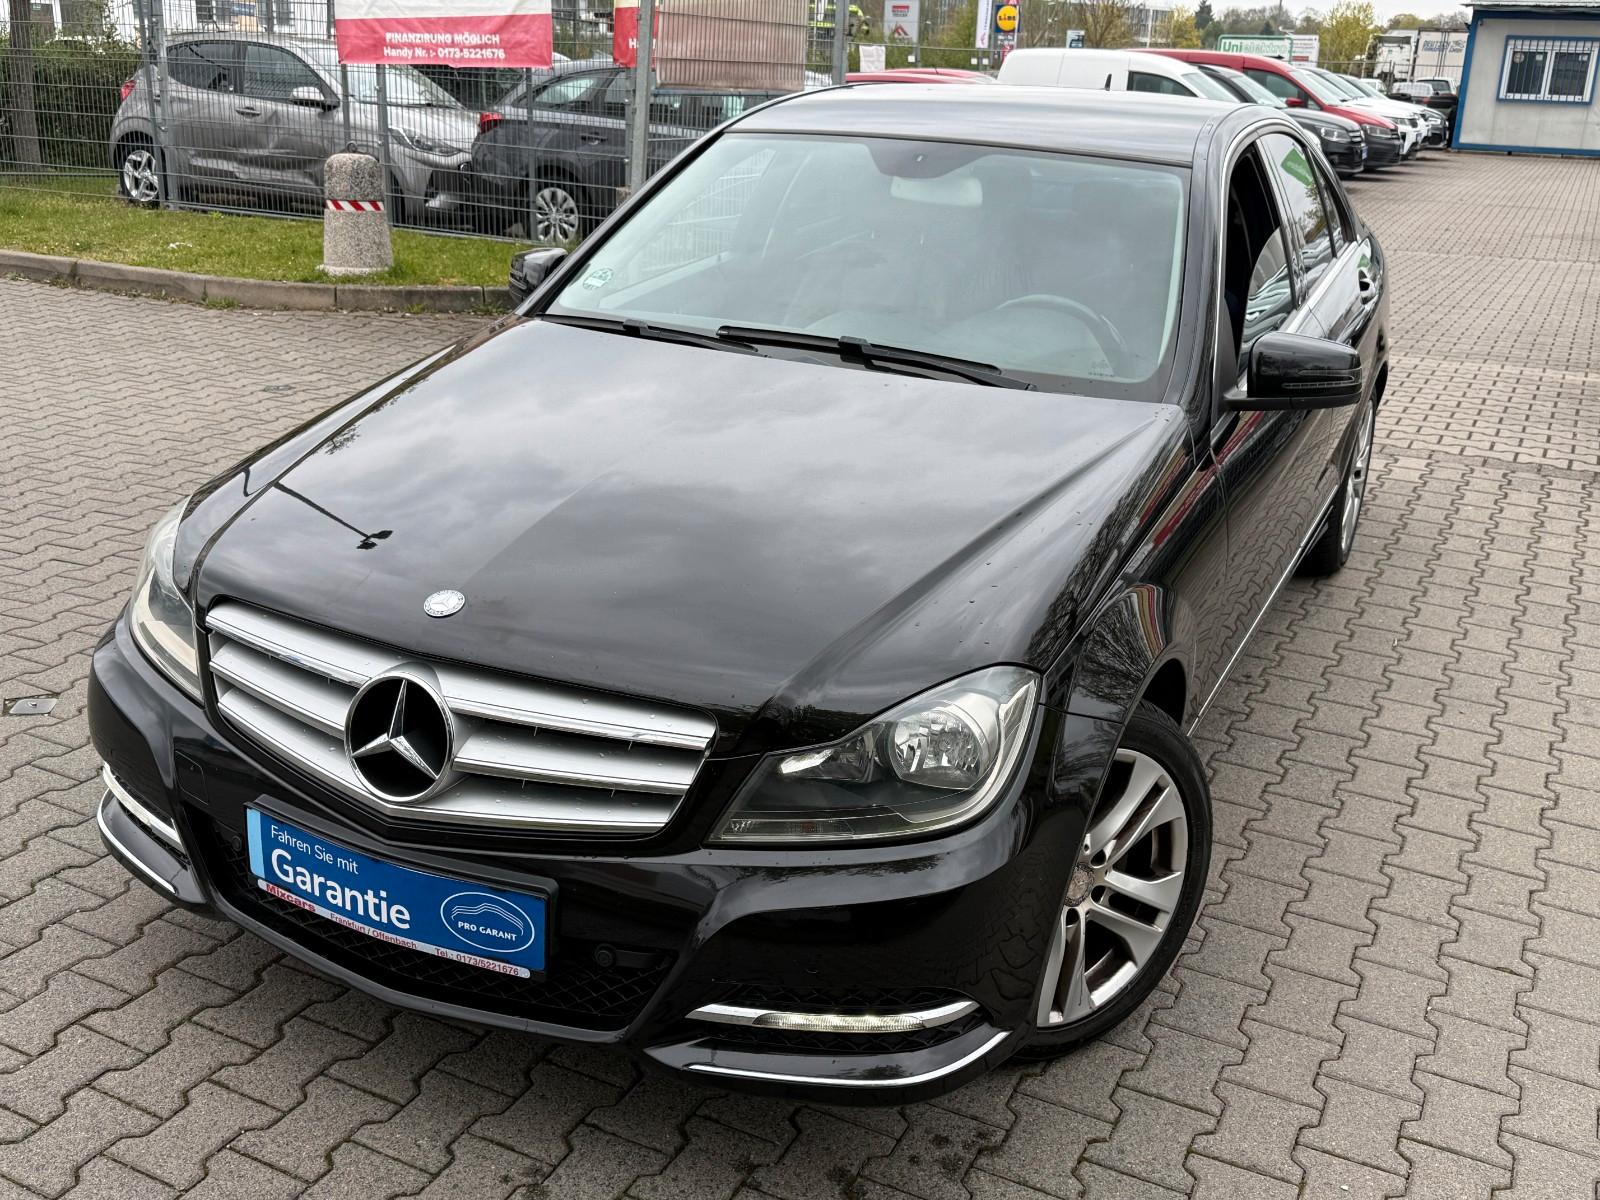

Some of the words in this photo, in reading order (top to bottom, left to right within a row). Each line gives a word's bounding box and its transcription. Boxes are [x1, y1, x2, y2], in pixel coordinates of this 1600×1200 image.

[383, 46, 414, 60] Handy
[437, 47, 506, 60] 0173-5221676
[385, 32, 452, 44] FINANZIRUNG
[453, 32, 500, 45] MÖGLICH
[271, 824, 311, 855] Fahren
[314, 844, 333, 864] Sie
[337, 857, 359, 875] mit
[271, 848, 411, 930] Garantie
[265, 882, 316, 912] Mixcars
[330, 912, 366, 934] Frankfurt
[372, 929, 417, 950] Offenbach
[456, 953, 519, 976] 0173/5221676
[457, 921, 477, 931] PRO
[479, 926, 517, 942] GARANT
